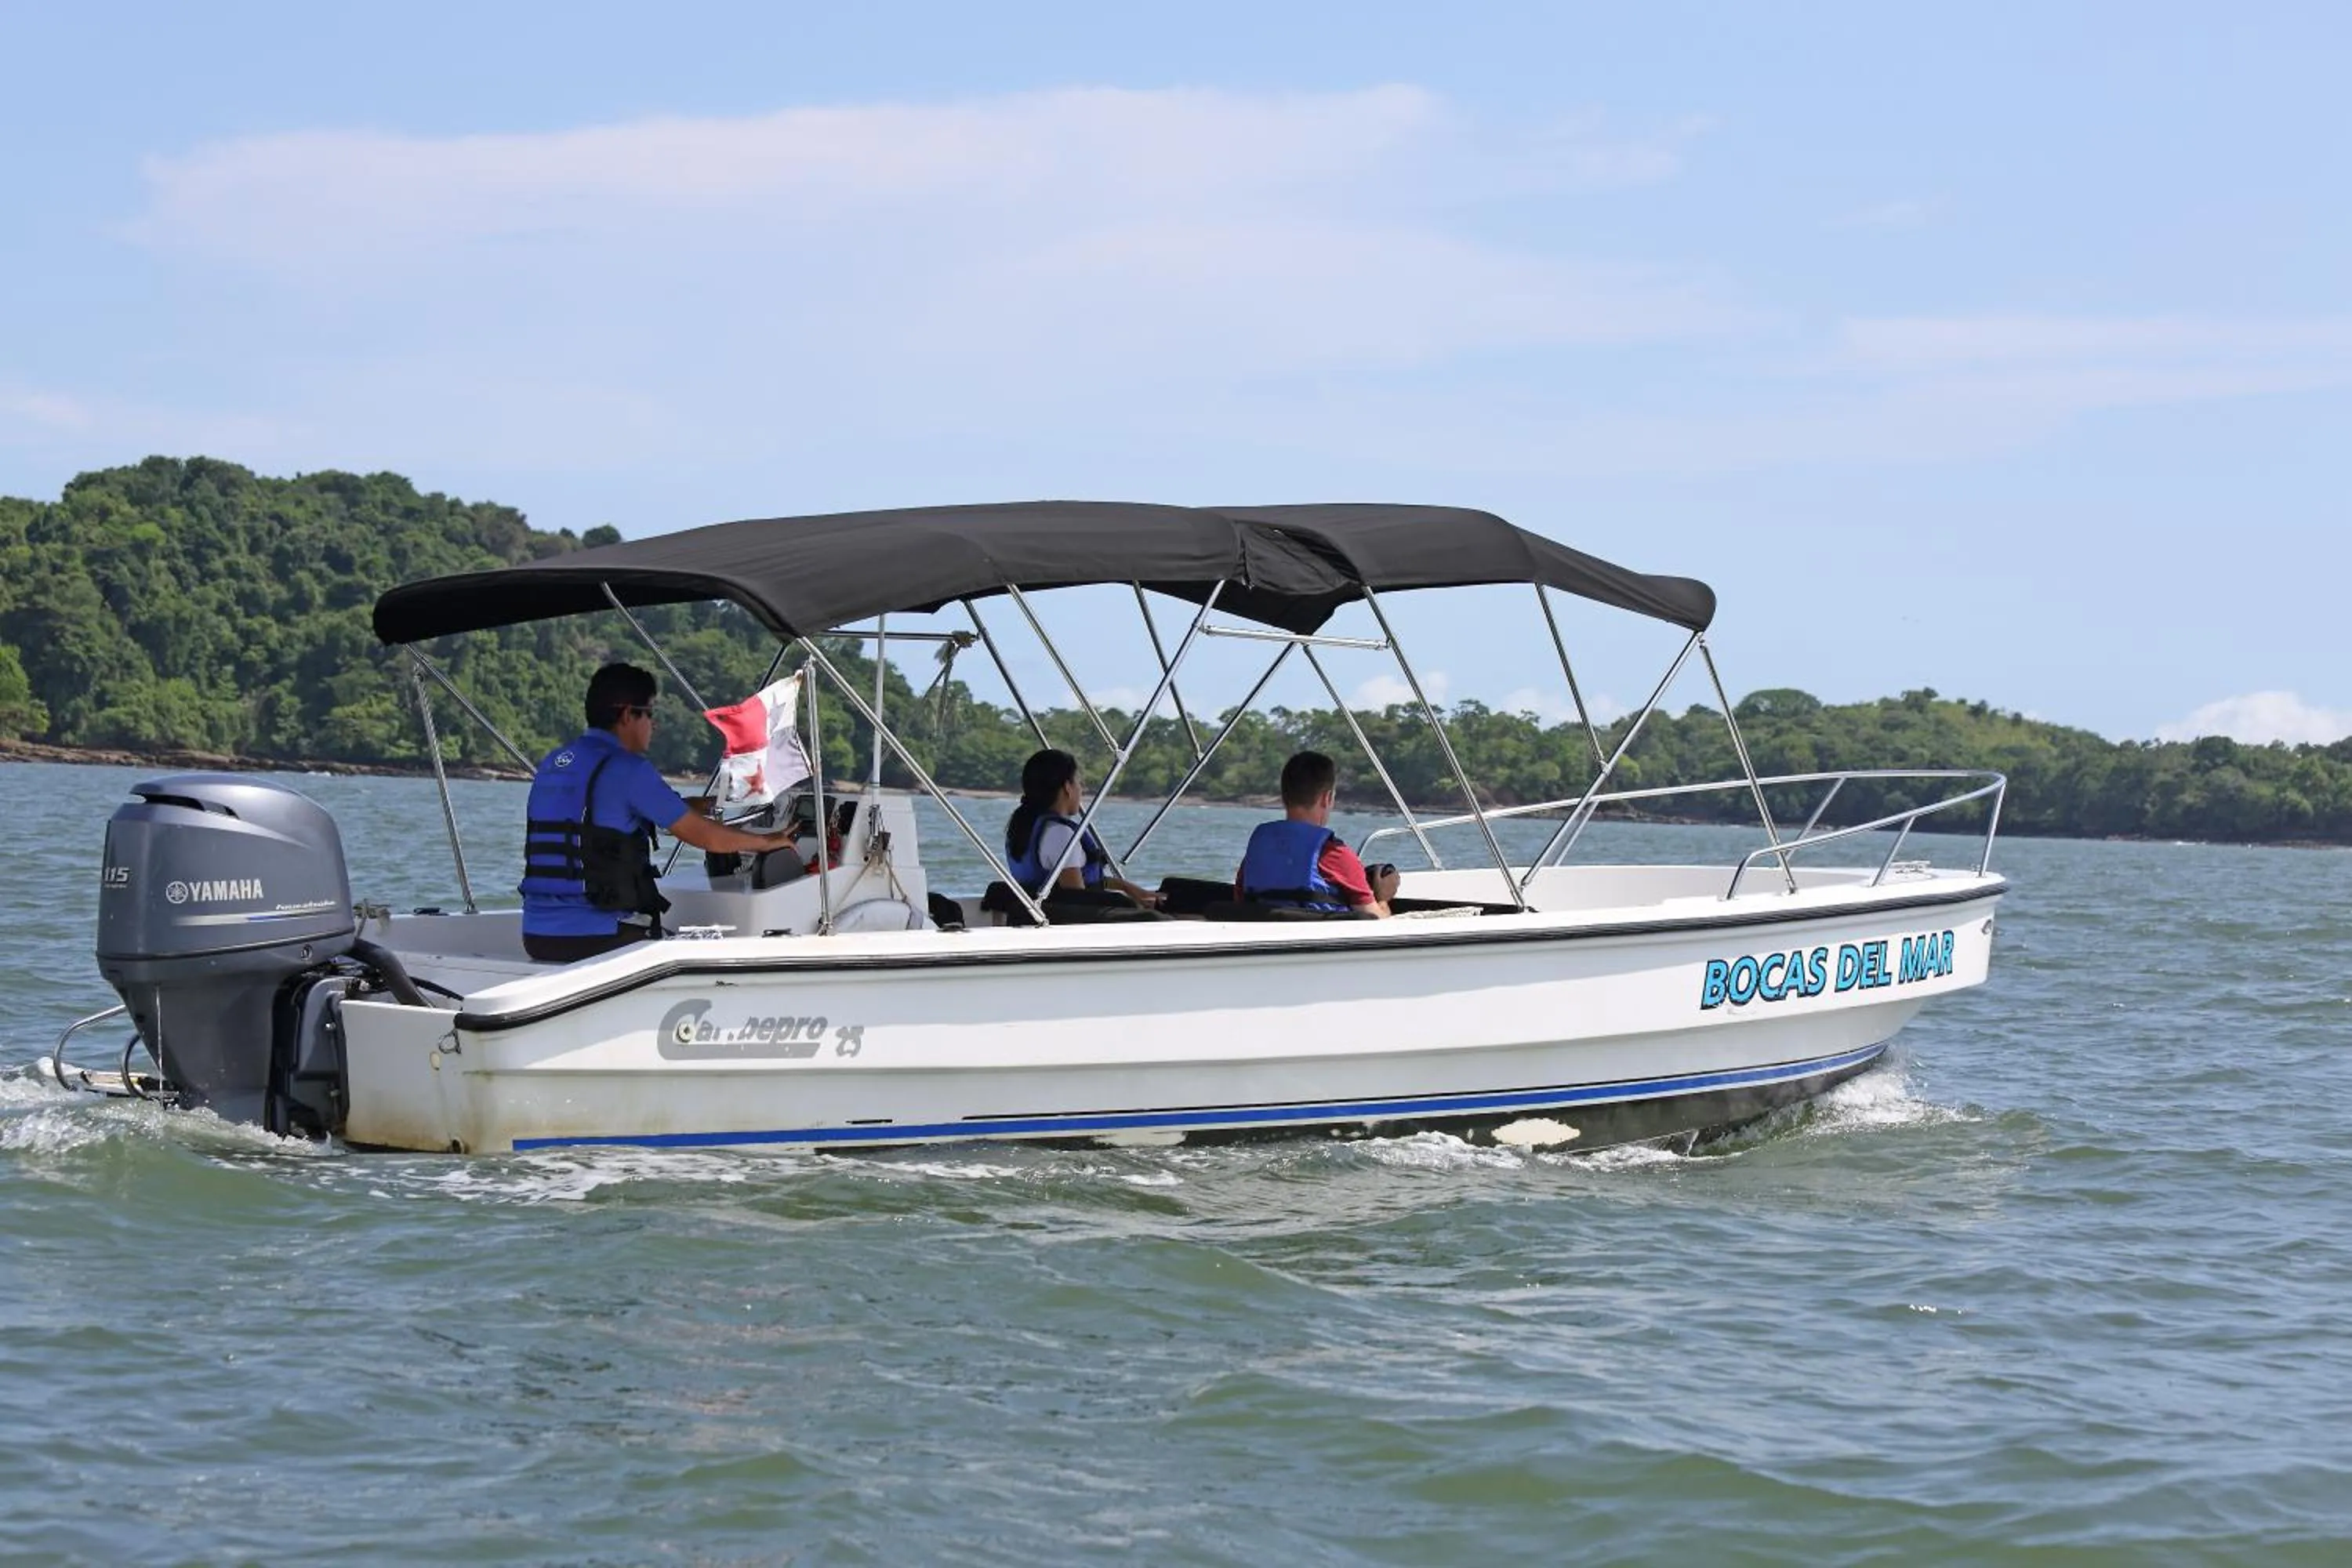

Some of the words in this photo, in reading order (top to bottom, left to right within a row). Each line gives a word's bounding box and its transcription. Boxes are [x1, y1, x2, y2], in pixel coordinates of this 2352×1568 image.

[104, 866, 129, 882] 115
[189, 878, 264, 902] YAMAHA
[1700, 946, 1828, 1010] BOCAS
[1835, 940, 1892, 992] DEL
[1898, 930, 1954, 983] MAR
